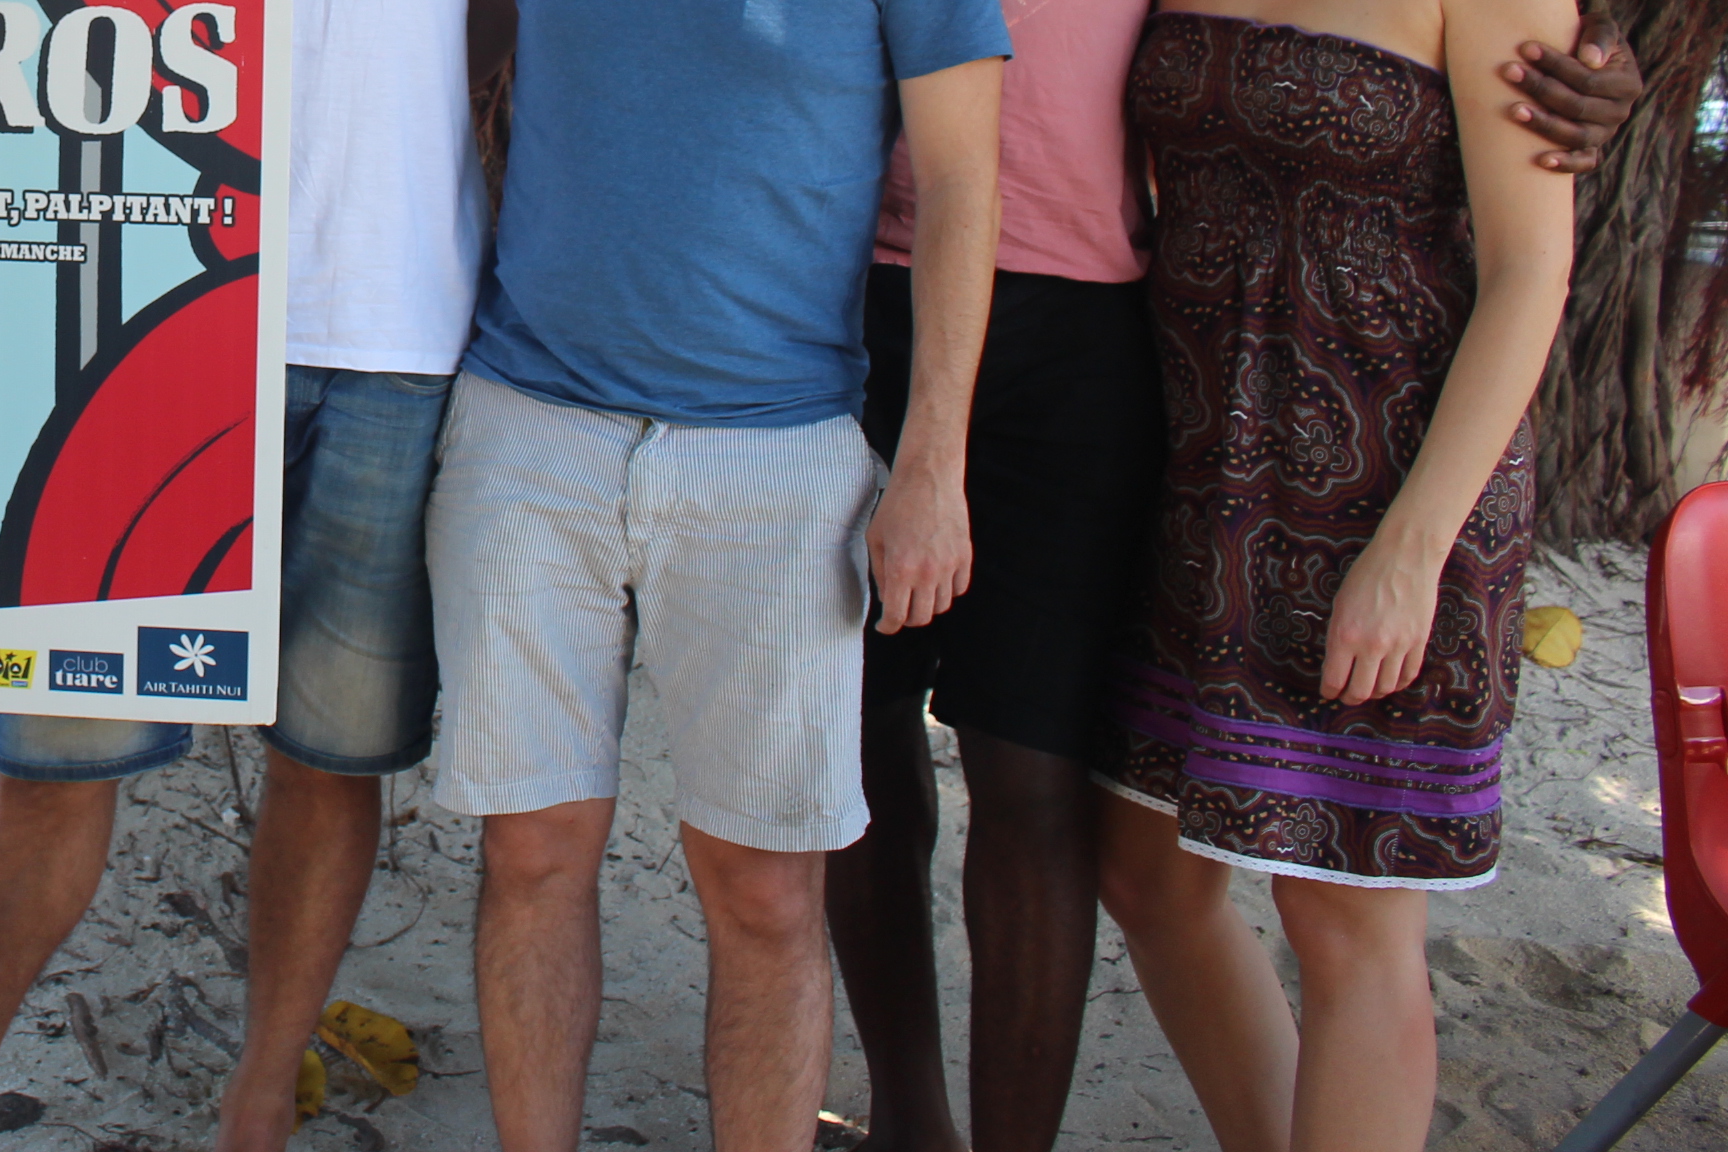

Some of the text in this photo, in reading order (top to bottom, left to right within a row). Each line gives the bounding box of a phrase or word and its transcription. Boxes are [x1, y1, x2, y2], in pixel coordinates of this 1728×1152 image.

[25, 192, 215, 225] PALPITANT
[223, 198, 234, 225] !
[63, 656, 109, 673] club
[54, 668, 119, 689] tiare
[143, 680, 242, 696] AIR TAHITI NUI
